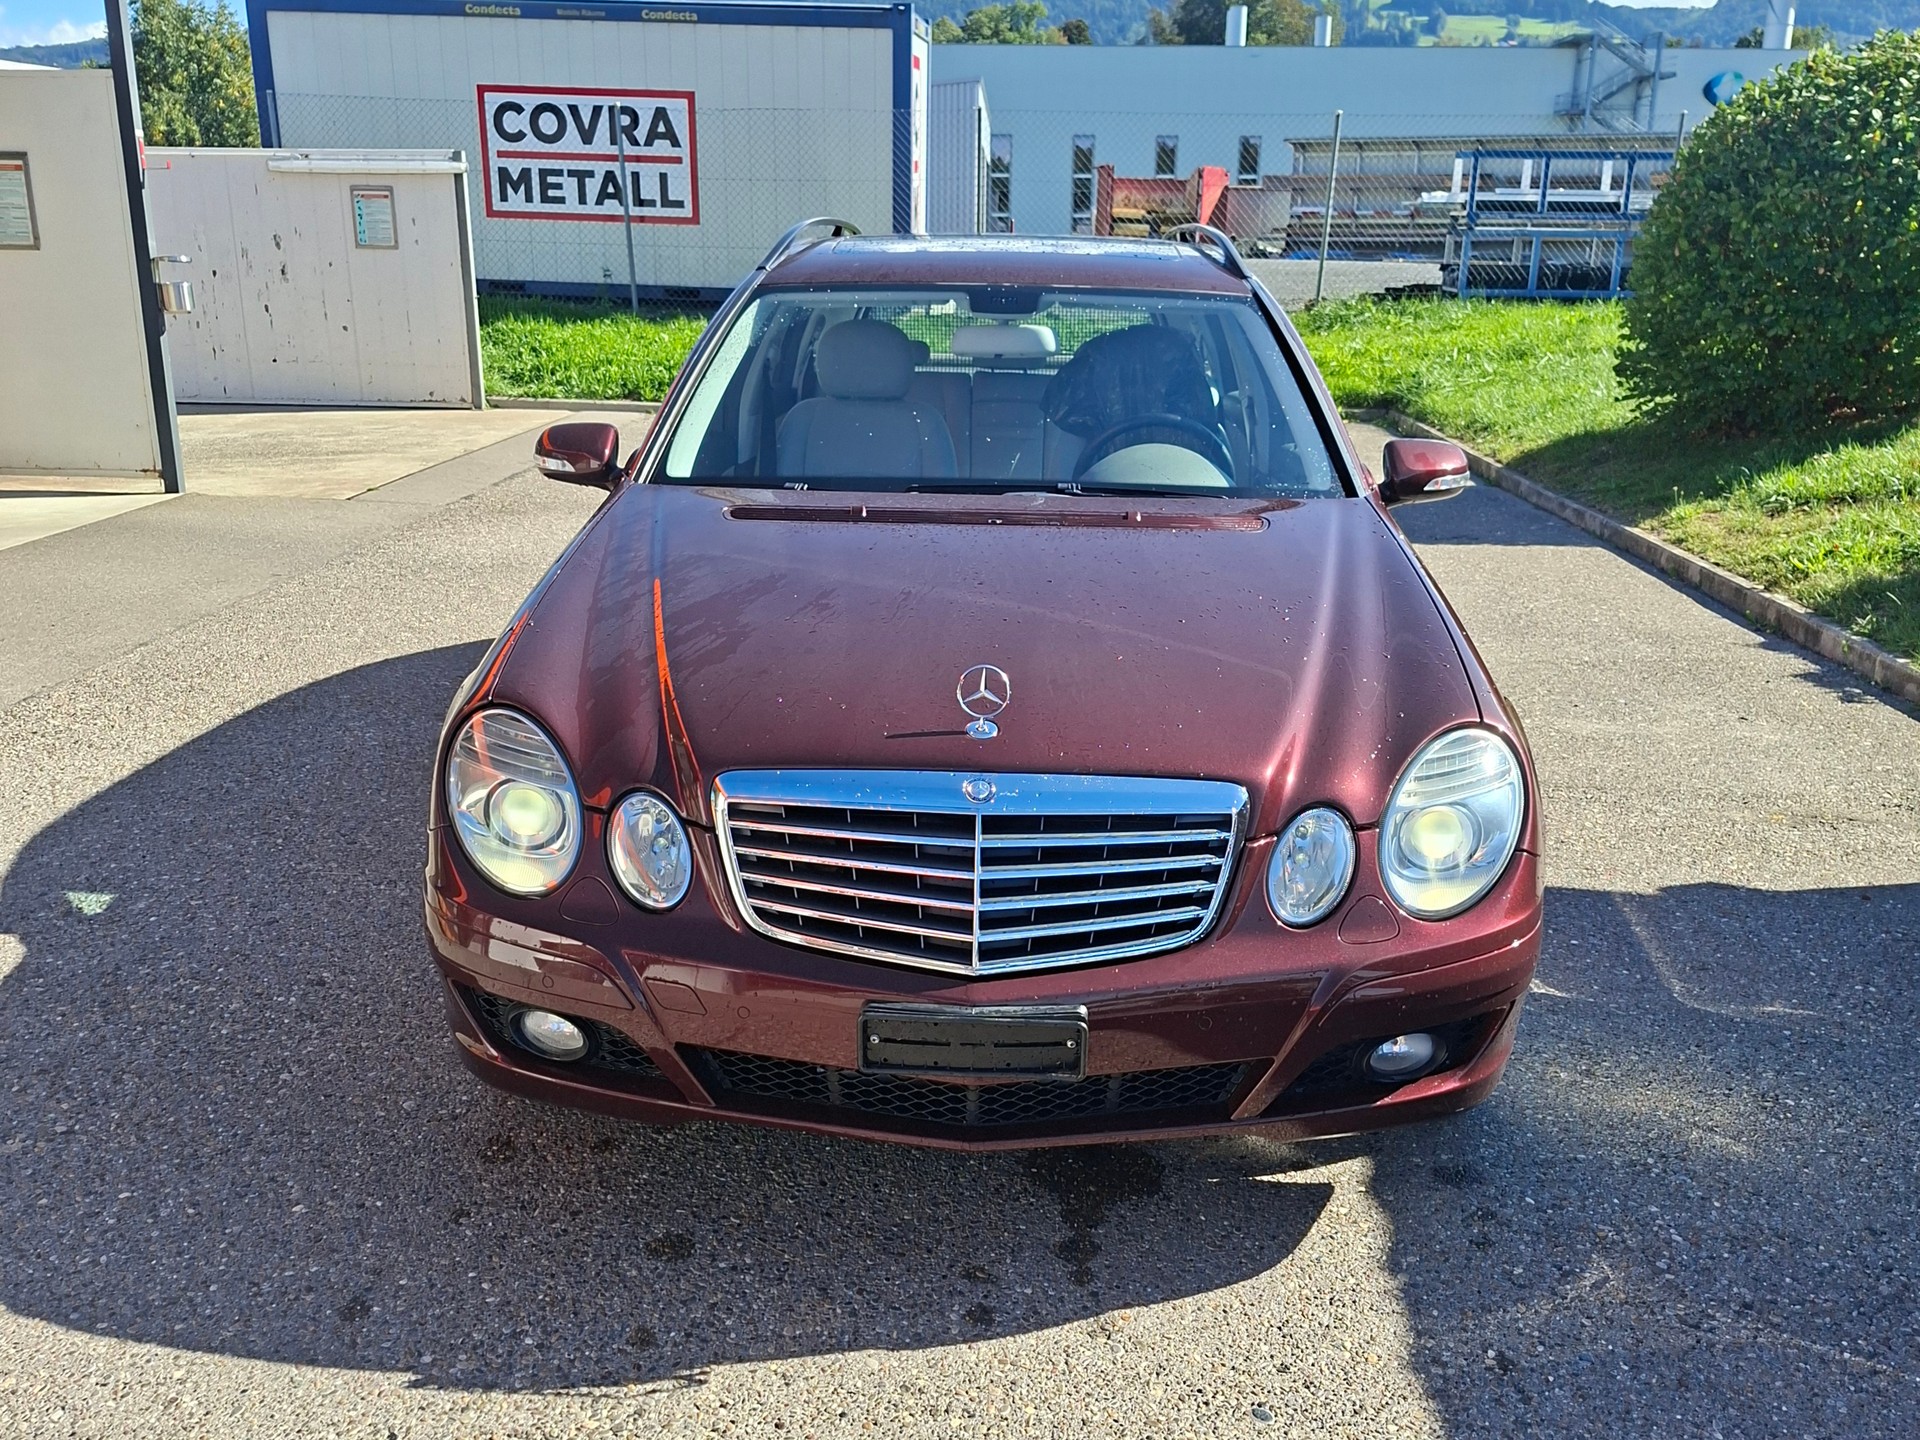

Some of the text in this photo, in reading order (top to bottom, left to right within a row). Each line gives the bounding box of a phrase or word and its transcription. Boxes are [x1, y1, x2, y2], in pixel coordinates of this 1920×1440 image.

[464, 3, 522, 16] Condecta
[641, 9, 698, 21] Condecta
[493, 101, 682, 148] COVRA
[497, 166, 685, 209] METALL
